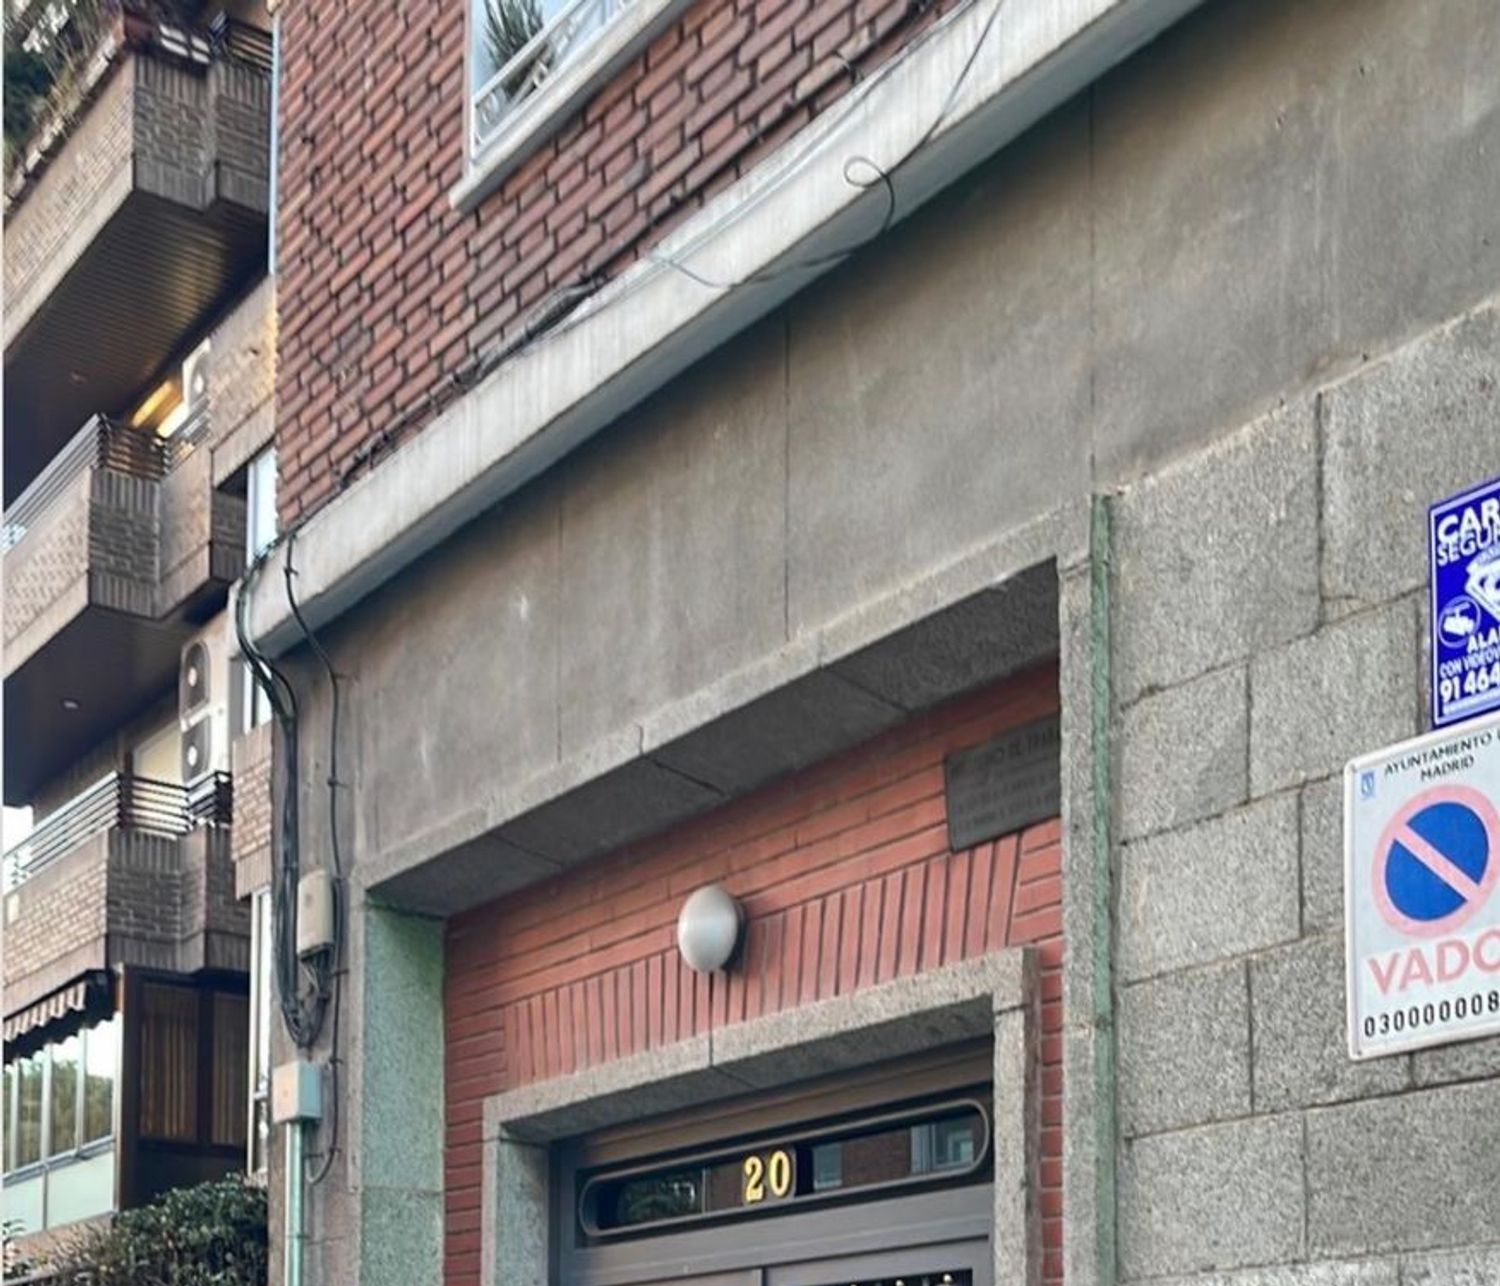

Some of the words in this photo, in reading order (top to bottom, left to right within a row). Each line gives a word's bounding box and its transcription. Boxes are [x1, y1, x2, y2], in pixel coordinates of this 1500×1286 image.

[1440, 676, 1461, 703] 91
[1385, 731, 1492, 776] AYUNTAMIENTO
[1420, 755, 1475, 781] MADRID
[1364, 990, 1500, 1038] 030000008
[744, 1150, 790, 1203] 20
